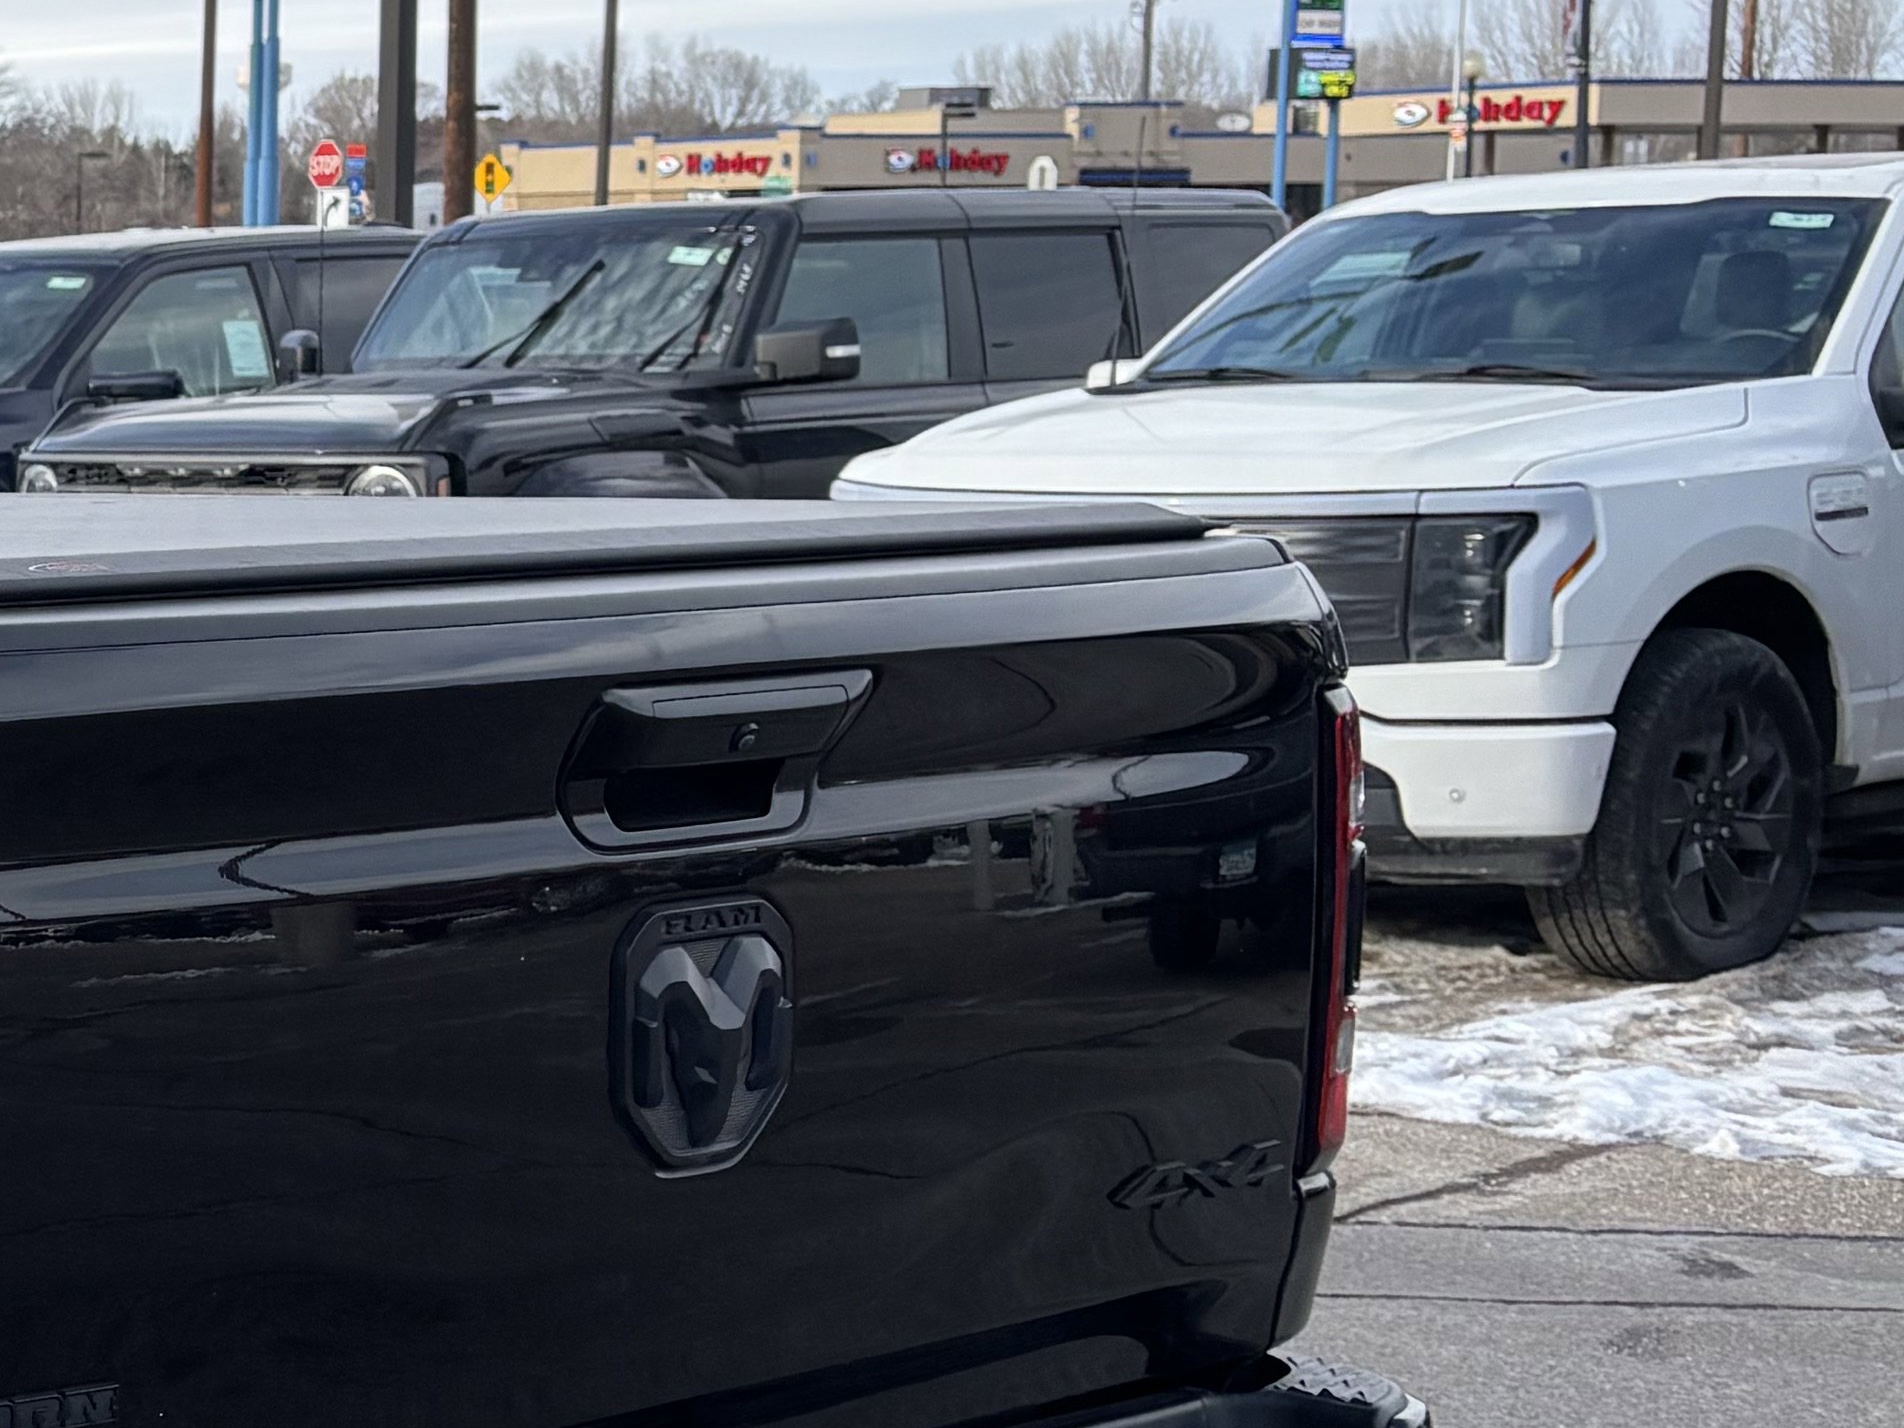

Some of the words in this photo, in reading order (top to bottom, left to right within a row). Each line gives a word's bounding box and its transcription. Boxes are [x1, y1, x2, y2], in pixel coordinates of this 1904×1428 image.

[310, 155, 341, 176] STOP
[685, 151, 772, 179] Holiday
[664, 904, 762, 936] RAM
